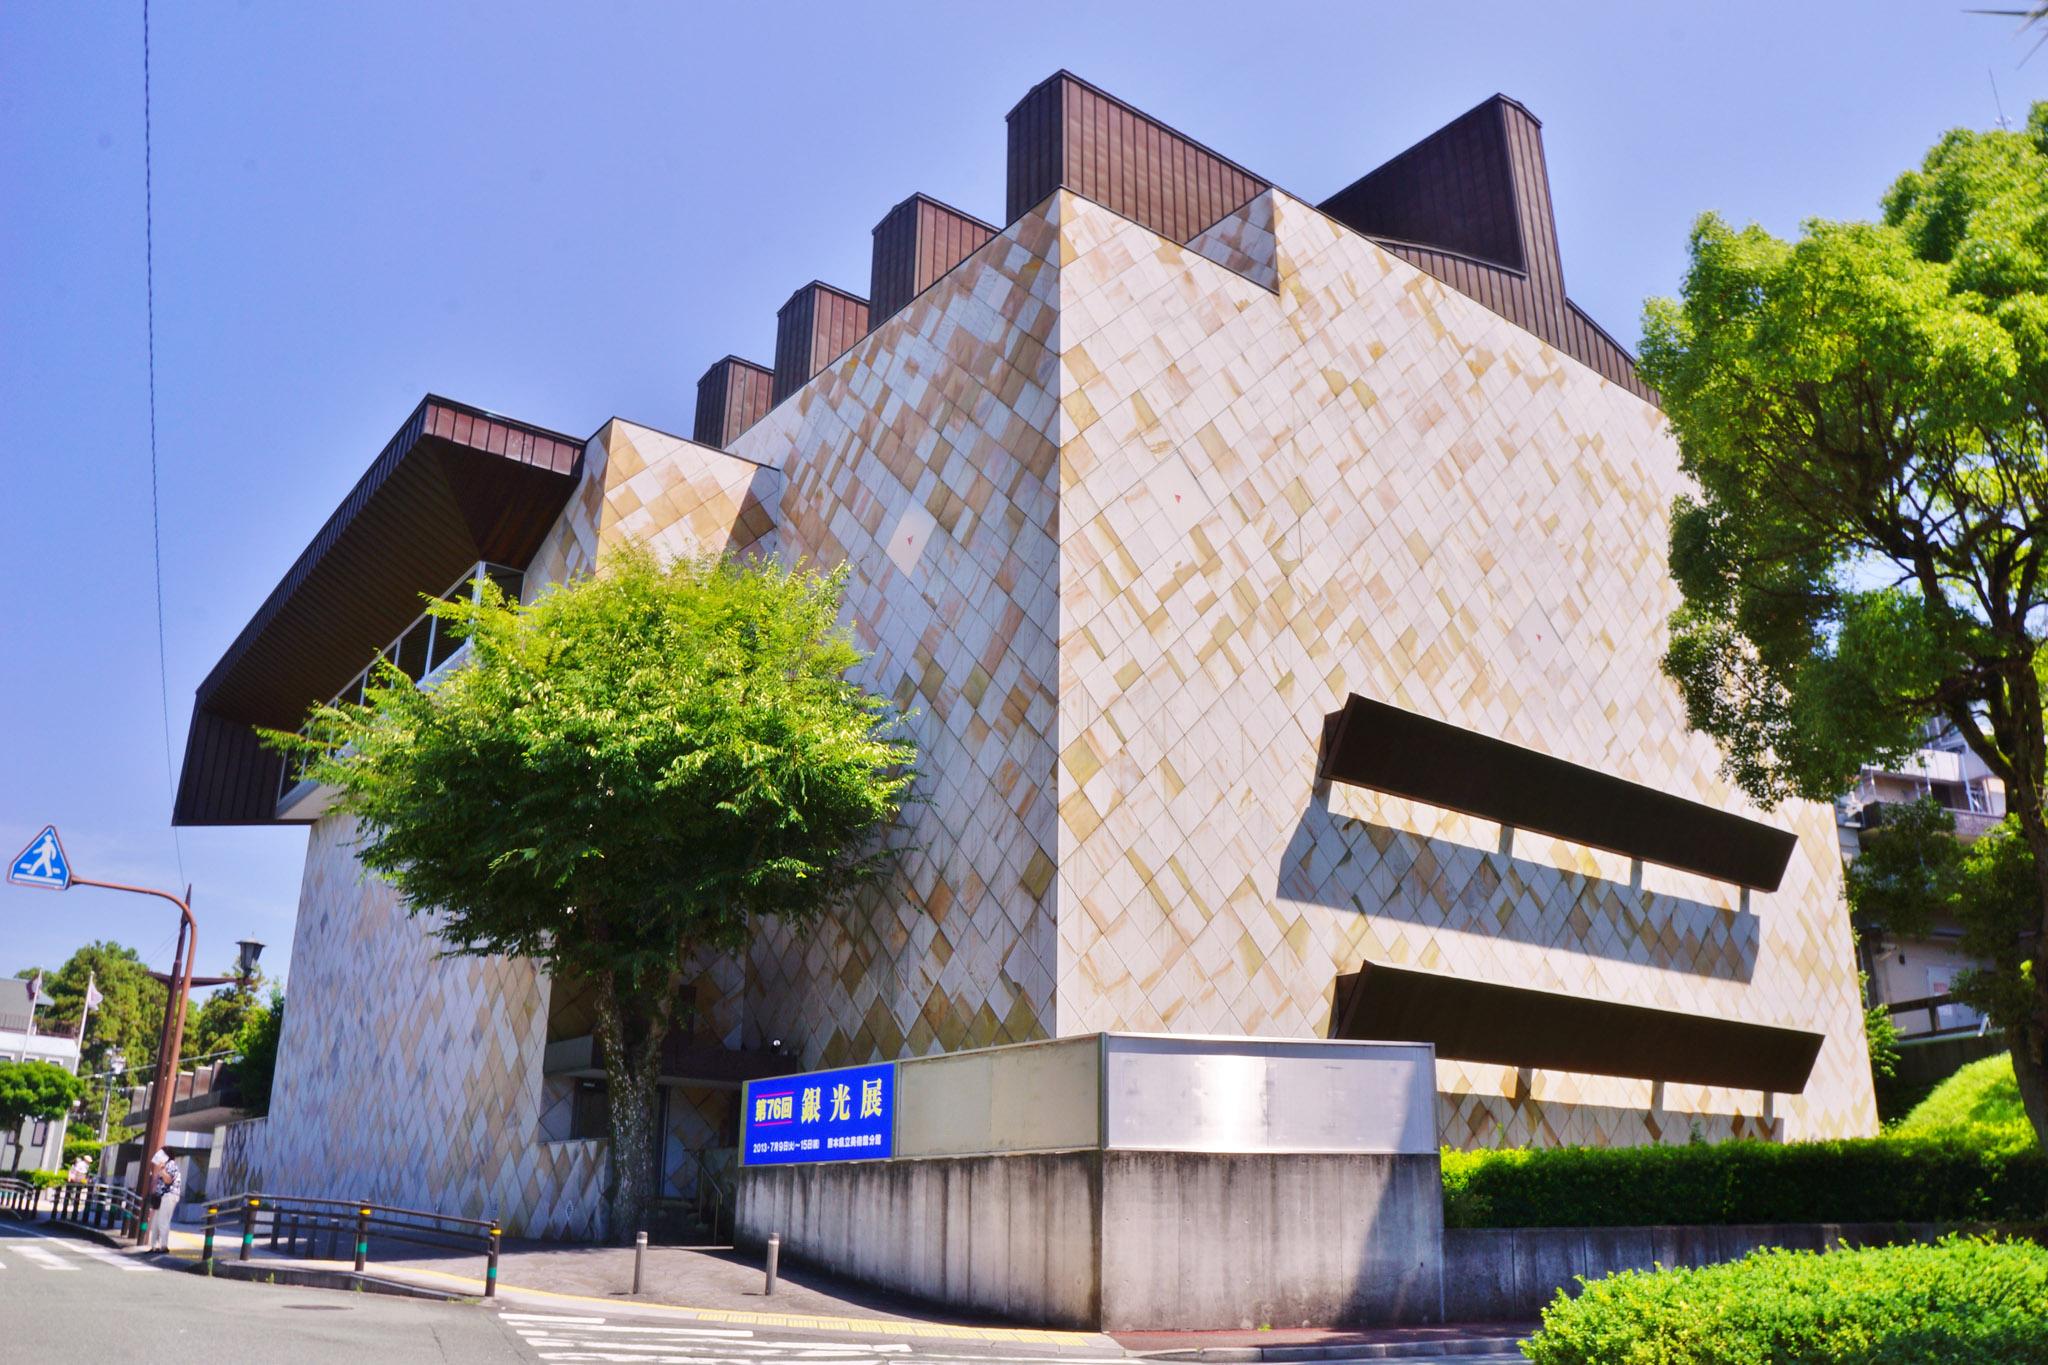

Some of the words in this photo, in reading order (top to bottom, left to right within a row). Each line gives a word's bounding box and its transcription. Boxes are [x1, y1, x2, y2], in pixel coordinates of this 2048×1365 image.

[755, 1097, 792, 1122] 第76回
[802, 1079, 882, 1123] 銀光展
